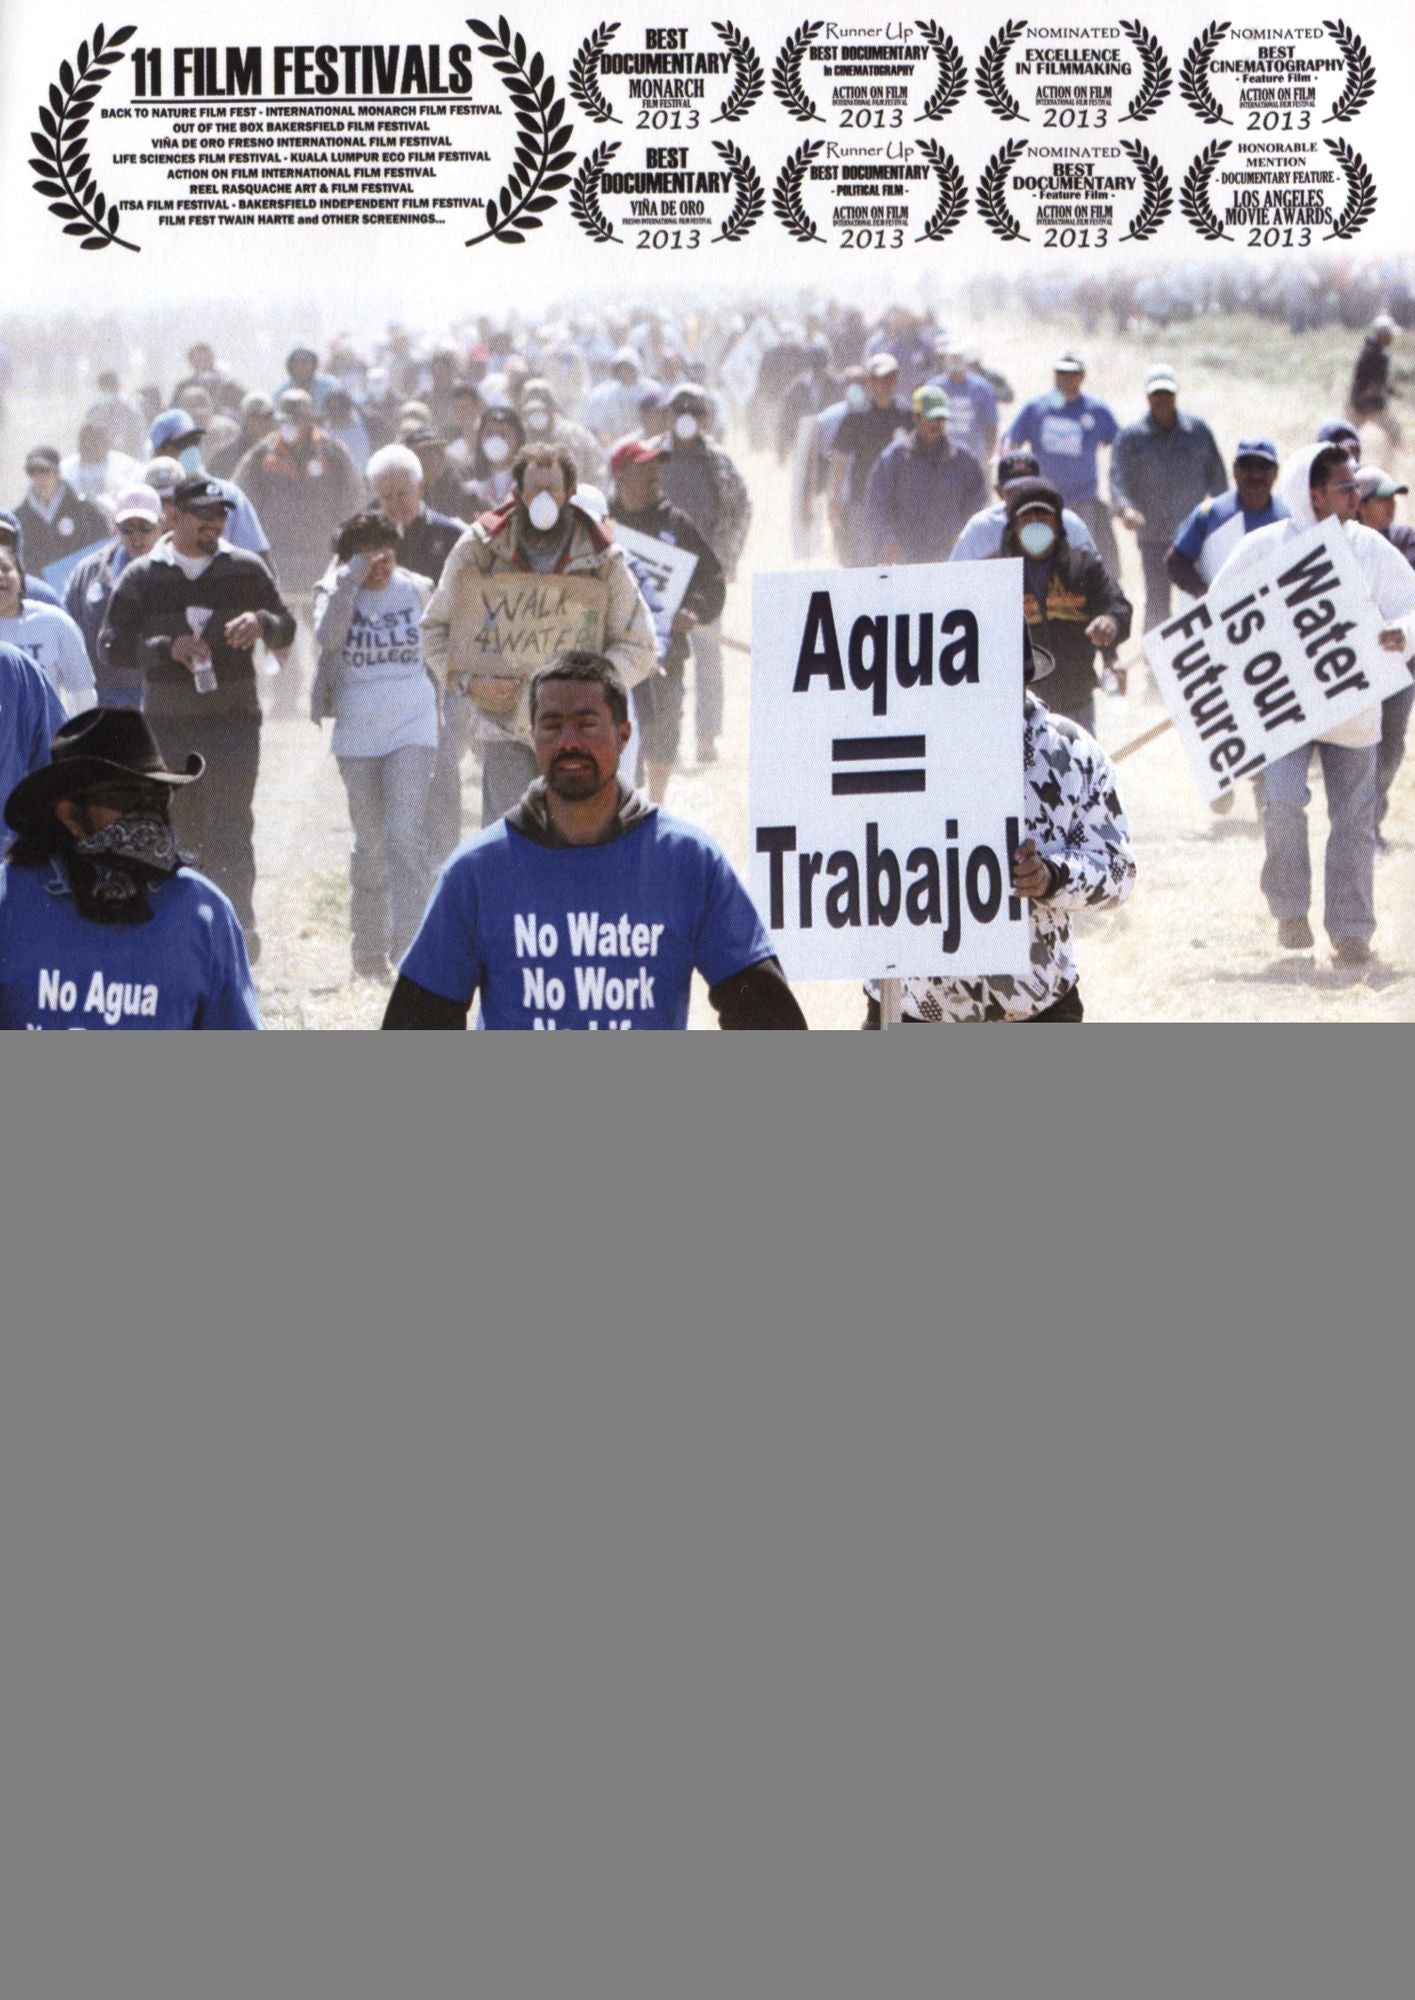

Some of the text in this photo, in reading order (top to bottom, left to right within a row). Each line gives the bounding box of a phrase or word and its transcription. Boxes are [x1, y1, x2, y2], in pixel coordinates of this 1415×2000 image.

[645, 27, 689, 50] BEST
[826, 22, 914, 42] Runner Up
[1027, 28, 1120, 39] NOMINATED
[1231, 28, 1323, 39] NOMINATED
[810, 45, 930, 61] BEST DOCUMENTARY
[1025, 49, 1121, 62] EXCELLENCE
[1258, 45, 1296, 60] BEST
[130, 43, 473, 97] 11 FILM FESTIVALS
[601, 53, 732, 74] DOCUMENTARY
[833, 64, 915, 77] CINEMATOGRAPHY
[1015, 62, 1132, 75] IN FILMMAKING
[1210, 60, 1345, 73] CINEMATOGRAPHY
[1242, 72, 1311, 84] Feature Film
[628, 78, 705, 99] MONARCH
[832, 85, 908, 100] ACTION ON FILM
[1035, 85, 1113, 100] ACTION ON FILM
[1239, 87, 1316, 102] ACTION ON FILM
[100, 104, 503, 119] BACK TO NATURE FILM FEST INTERNATIONAL MONARCH FILM FESTIVAL
[641, 99, 692, 109] FILM FESTIVAL
[635, 109, 700, 130] 2013
[839, 108, 903, 129] 2013
[1042, 108, 1107, 129] 2013
[1246, 110, 1311, 131] 2013
[172, 120, 430, 134] OUT OF THE BOX BAKERSFIELD FILM FESTIVAL
[151, 135, 453, 149] VIÑA DE ORO FRESNO INTERNATIONAL FILM FESTIVAL
[826, 140, 915, 160] Runner Up
[1237, 142, 1318, 154] HONORABLE
[112, 151, 491, 165] LIFE SCIENCES FILM FESTIVAL KUALA LUMPUR ECO FILM FESTIVAL
[645, 146, 690, 170] BEST
[1027, 146, 1122, 158] NOMINATED
[1052, 162, 1095, 178] BEST
[1246, 156, 1307, 168] MENTION
[167, 166, 437, 180] ACTION ON FILM INTERNATIONAL FILM FESTIVAL
[809, 164, 931, 181] BEST DOCUMENTARY
[1221, 170, 1335, 185] DOCUMENTARY FEATURE
[189, 182, 415, 196] REEL RASQUACHE ART & FILM FESTIVAL
[601, 172, 732, 194] DOCUMENTARY
[836, 184, 904, 197] POLITICAL FILM
[1013, 176, 1137, 190] DOCUMENTARY
[1039, 189, 1109, 200] Feature Film
[1233, 189, 1324, 208] LOS ANGELES
[119, 197, 485, 211] ITSA FILM FESTIVAL BAKERSFIELD INDEPENDENT FILM FESTIVAL
[629, 197, 705, 217] VIÑA DE ORO
[1036, 204, 1113, 220] ACTION ON FILM
[158, 213, 446, 226] FILM FEST TWAIN HARTE and OTHER SCREENINGS...
[832, 205, 909, 220] ACTION ON FILM
[1225, 206, 1333, 225] MOVIE AWARDS
[636, 229, 701, 250] 2013
[839, 228, 904, 249] 2013
[1043, 227, 1108, 248] 2013
[1247, 227, 1312, 248] 2013
[480, 588, 572, 622] WALK
[1276, 543, 1370, 700] Water
[346, 627, 419, 648] HILLS
[792, 590, 981, 716] Aqua
[1219, 585, 1306, 732] is our
[1160, 603, 1267, 790] Future!
[756, 817, 1022, 953] Trabajo!
[513, 911, 665, 958] No Water
[521, 965, 655, 1011] No Work
[38, 968, 159, 1026] No Agua
